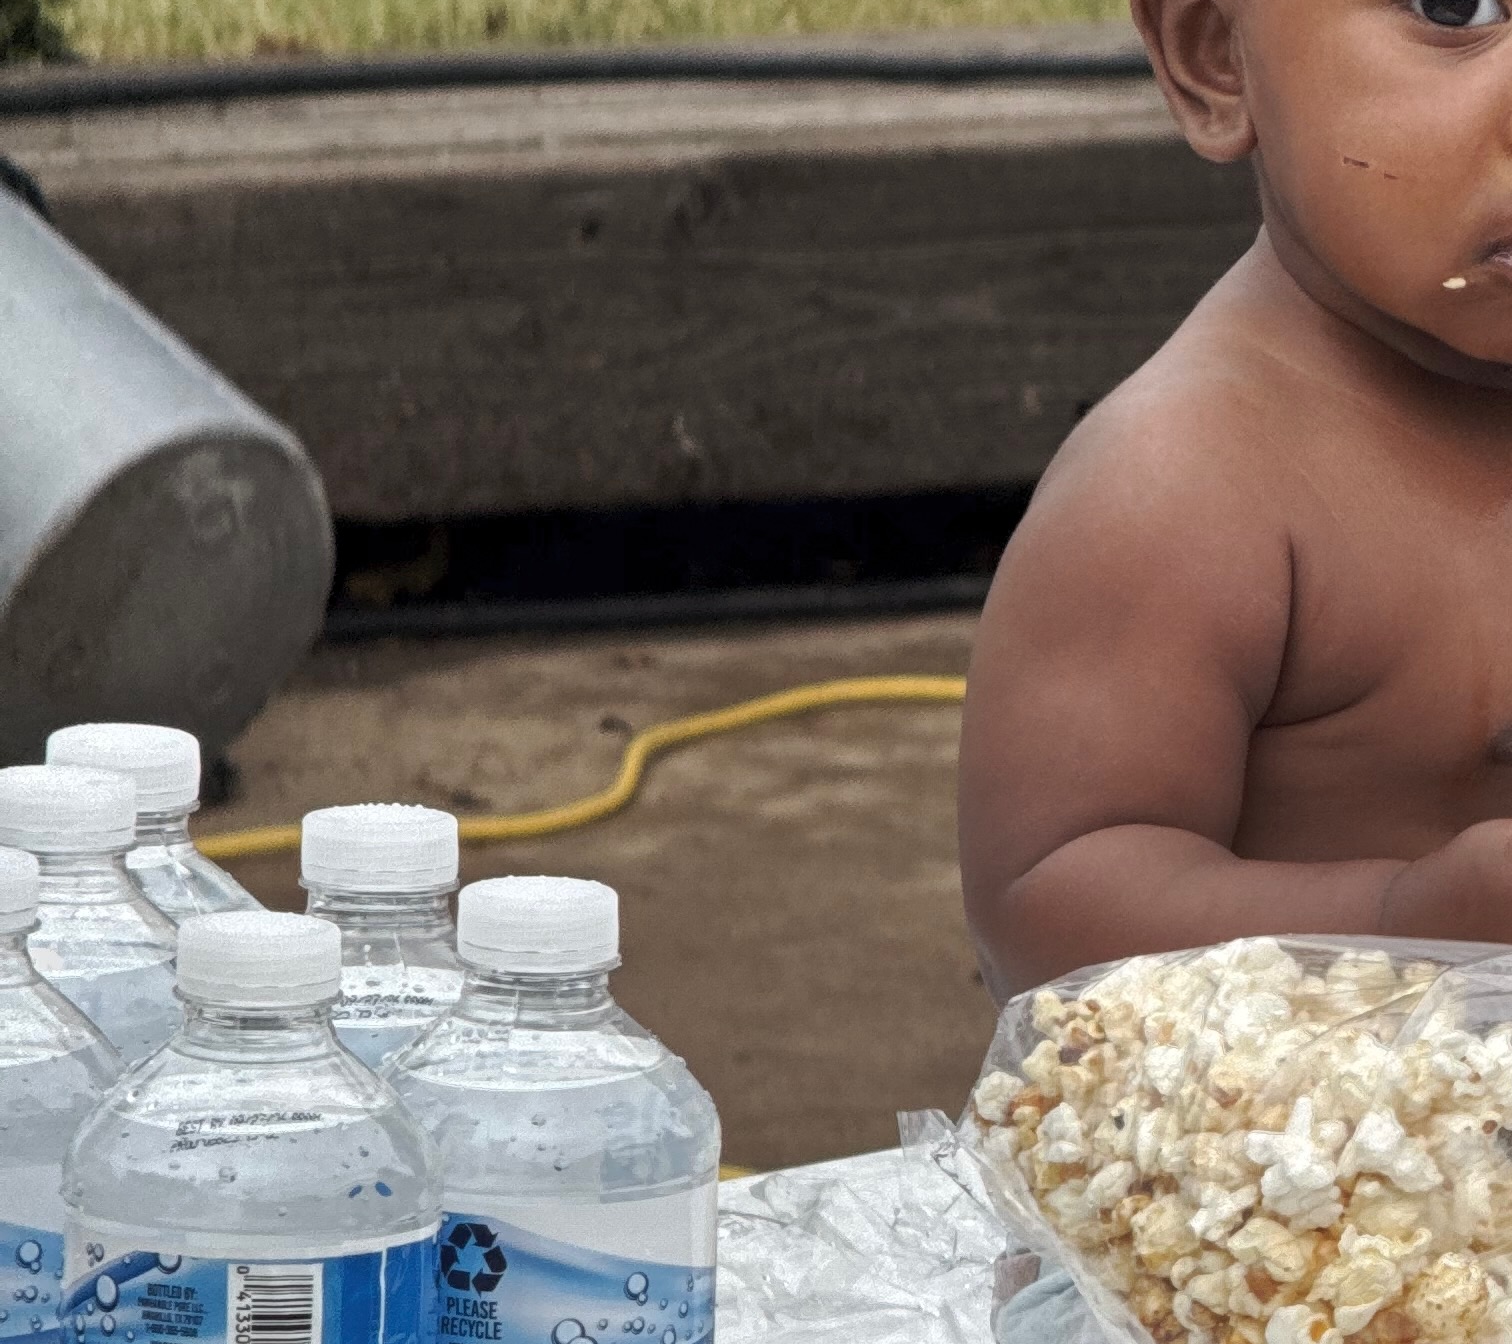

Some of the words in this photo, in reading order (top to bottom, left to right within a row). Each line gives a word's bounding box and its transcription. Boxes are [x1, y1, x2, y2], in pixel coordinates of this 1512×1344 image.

[237, 1266, 250, 1274] 0
[148, 1283, 182, 1299] BOTTLED
[235, 1291, 251, 1344] 41330
[446, 1297, 498, 1319] PLEASE
[441, 1316, 502, 1340] RECYCLE
